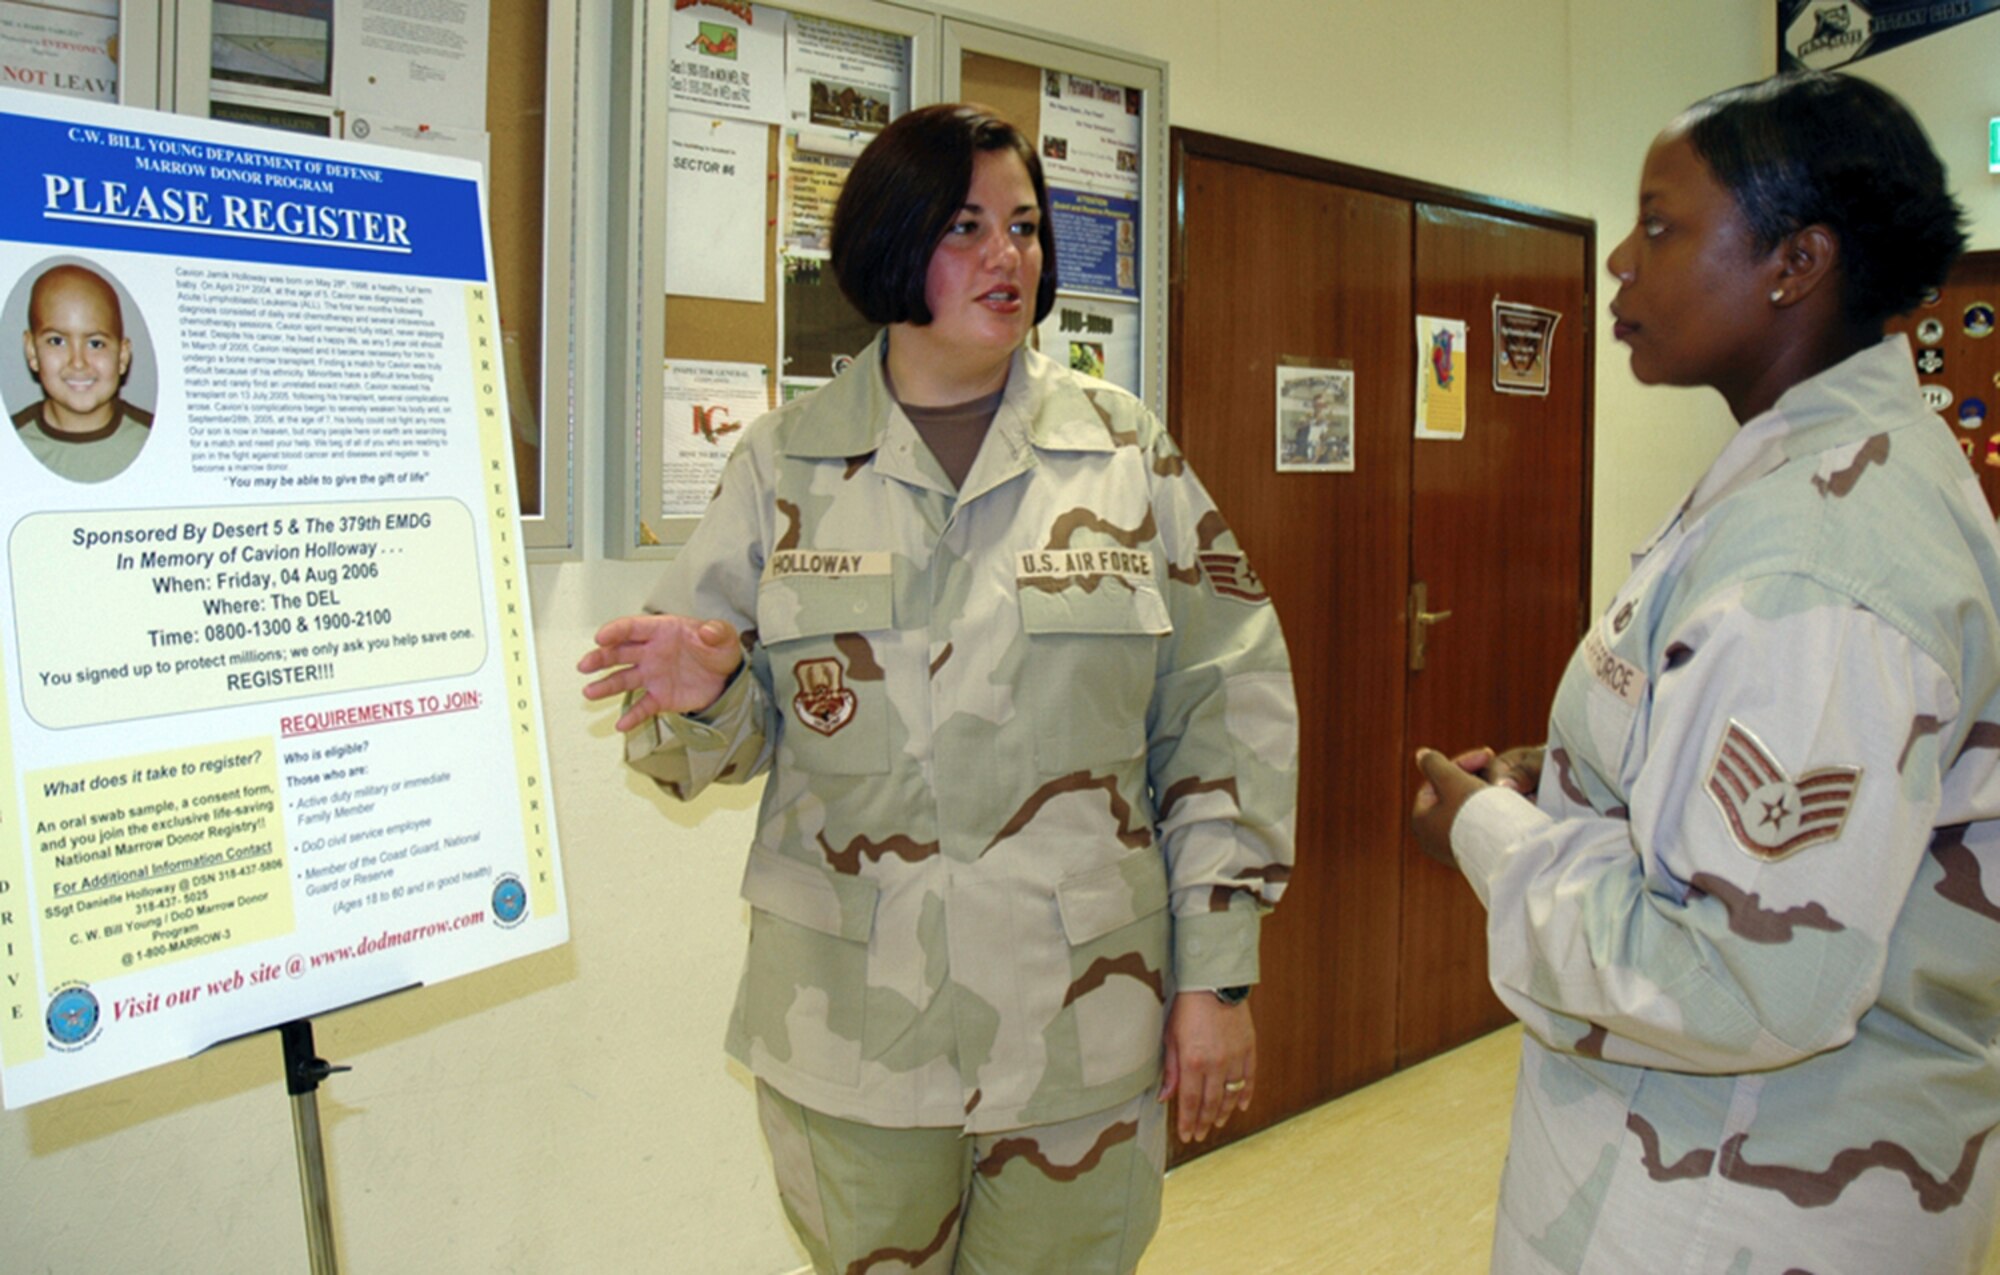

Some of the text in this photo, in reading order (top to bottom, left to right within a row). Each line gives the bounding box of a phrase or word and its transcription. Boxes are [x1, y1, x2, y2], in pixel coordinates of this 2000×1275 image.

[4, 65, 47, 86] NOT
[67, 127, 382, 182] C.W. BILL YOUNG DEPARTMENT OF DEFENSE
[673, 157, 734, 176] SECTOR #6
[135, 156, 333, 193] MARROW DONOR PROGRAM
[43, 174, 410, 245] PLEASE REGISTER
[473, 290, 495, 417] MARROW
[253, 477, 278, 489] may
[279, 475, 294, 486] be
[296, 474, 319, 485] able
[321, 475, 333, 485] to
[335, 474, 357, 487] give
[359, 473, 376, 484] the
[377, 472, 395, 486] gift
[396, 472, 408, 483] of
[72, 511, 431, 549] Sponsored By Desert 5 & The 379th EMDG
[116, 541, 377, 570] In Memory of Cavion Holloway
[772, 555, 861, 575] HOLLOWAY
[1022, 552, 1150, 575] U.S. AIR FORCE
[151, 561, 378, 594] When: Friday, 04 Aug 2006
[202, 589, 340, 616] Where: The DEL
[492, 461, 529, 733] REGISTRATION
[147, 607, 391, 647] Time: 0800-1300 & 1900-2100
[38, 628, 473, 686] You signed up to protect millions; we only ask you help save one.
[226, 662, 334, 691] REGISTER!!!
[279, 689, 482, 733] REQUIREMENTS TO JOIN:
[283, 739, 369, 764] Who is eligible?
[43, 749, 262, 797] What does it take to register?
[286, 773, 320, 787] Those
[322, 769, 346, 781] who
[295, 771, 451, 809] Active duty military or immediate
[35, 784, 274, 834] An oral swab sample, a consent form,
[40, 800, 274, 852] and you join the exclusive life-saving
[297, 802, 375, 825] Family Member
[301, 817, 431, 853] DoD civil service employee
[528, 776, 546, 883] DRIVE
[52, 840, 272, 894] For Additional Information Contact
[54, 845, 112, 868] National
[114, 838, 163, 856] Marrow
[165, 830, 205, 846] Donor
[304, 861, 347, 879] Member
[348, 856, 360, 870] of
[361, 855, 377, 867] the
[378, 847, 407, 863] Coast
[442, 830, 480, 848] National
[69, 892, 268, 945] C. W. Bill Young DoD Marrow Donor
[152, 923, 199, 941] Program
[113, 992, 160, 1021] Visit
[165, 985, 201, 1007] our
[206, 969, 244, 995] web
[249, 962, 281, 985] site
[284, 957, 306, 975] @
[309, 910, 484, 967] www.dodmarrow.com
